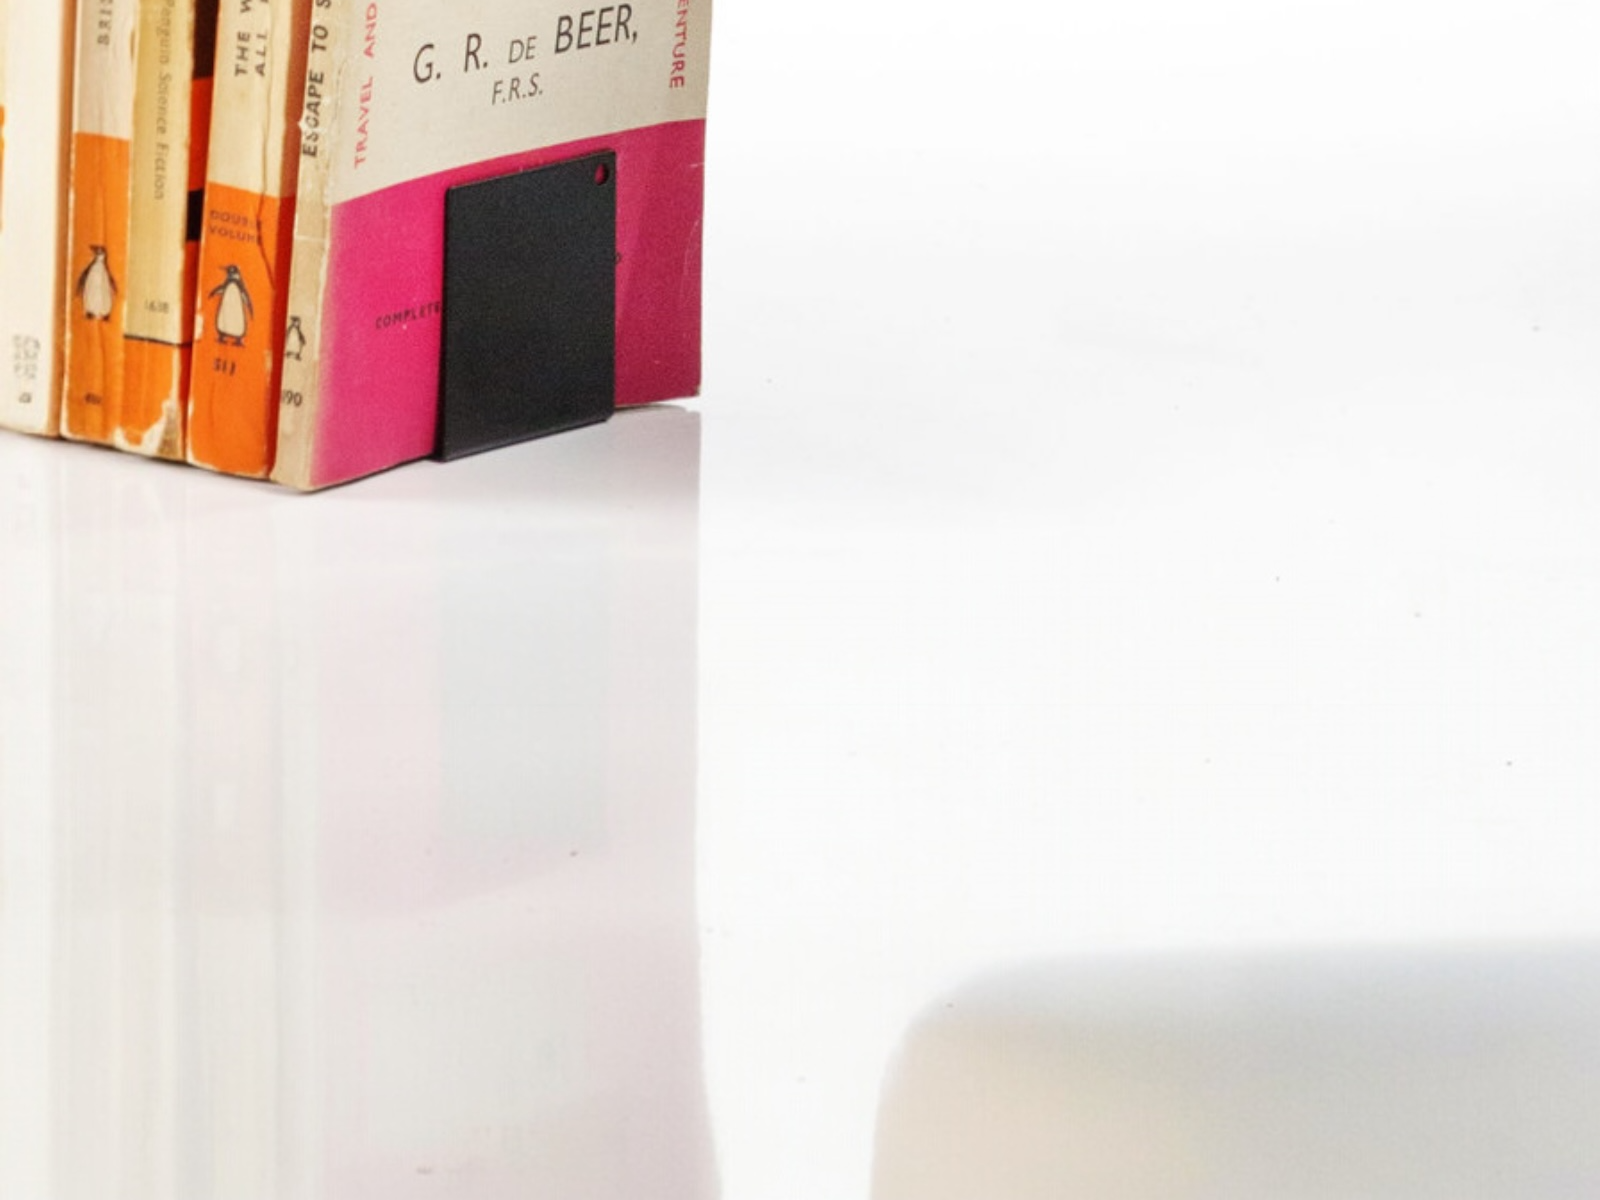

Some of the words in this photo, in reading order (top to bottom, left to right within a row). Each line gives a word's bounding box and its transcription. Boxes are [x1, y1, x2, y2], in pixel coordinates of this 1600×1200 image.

[234, 31, 251, 77] THE
[254, 29, 268, 78] ALL
[311, 24, 329, 53] TO
[413, 43, 442, 84] G.
[462, 34, 489, 71] R.
[508, 37, 538, 63] DE
[555, 4, 639, 55] BEER,
[157, 71, 173, 135] Science
[353, 75, 373, 170] TRAVEL
[364, 1, 378, 59] AND
[491, 73, 543, 106] F.R.S.
[302, 69, 324, 158] ESCAPE
[154, 142, 170, 200] Fiction
[210, 210, 261, 228] DOUB
[375, 301, 441, 330] COMPLETE
